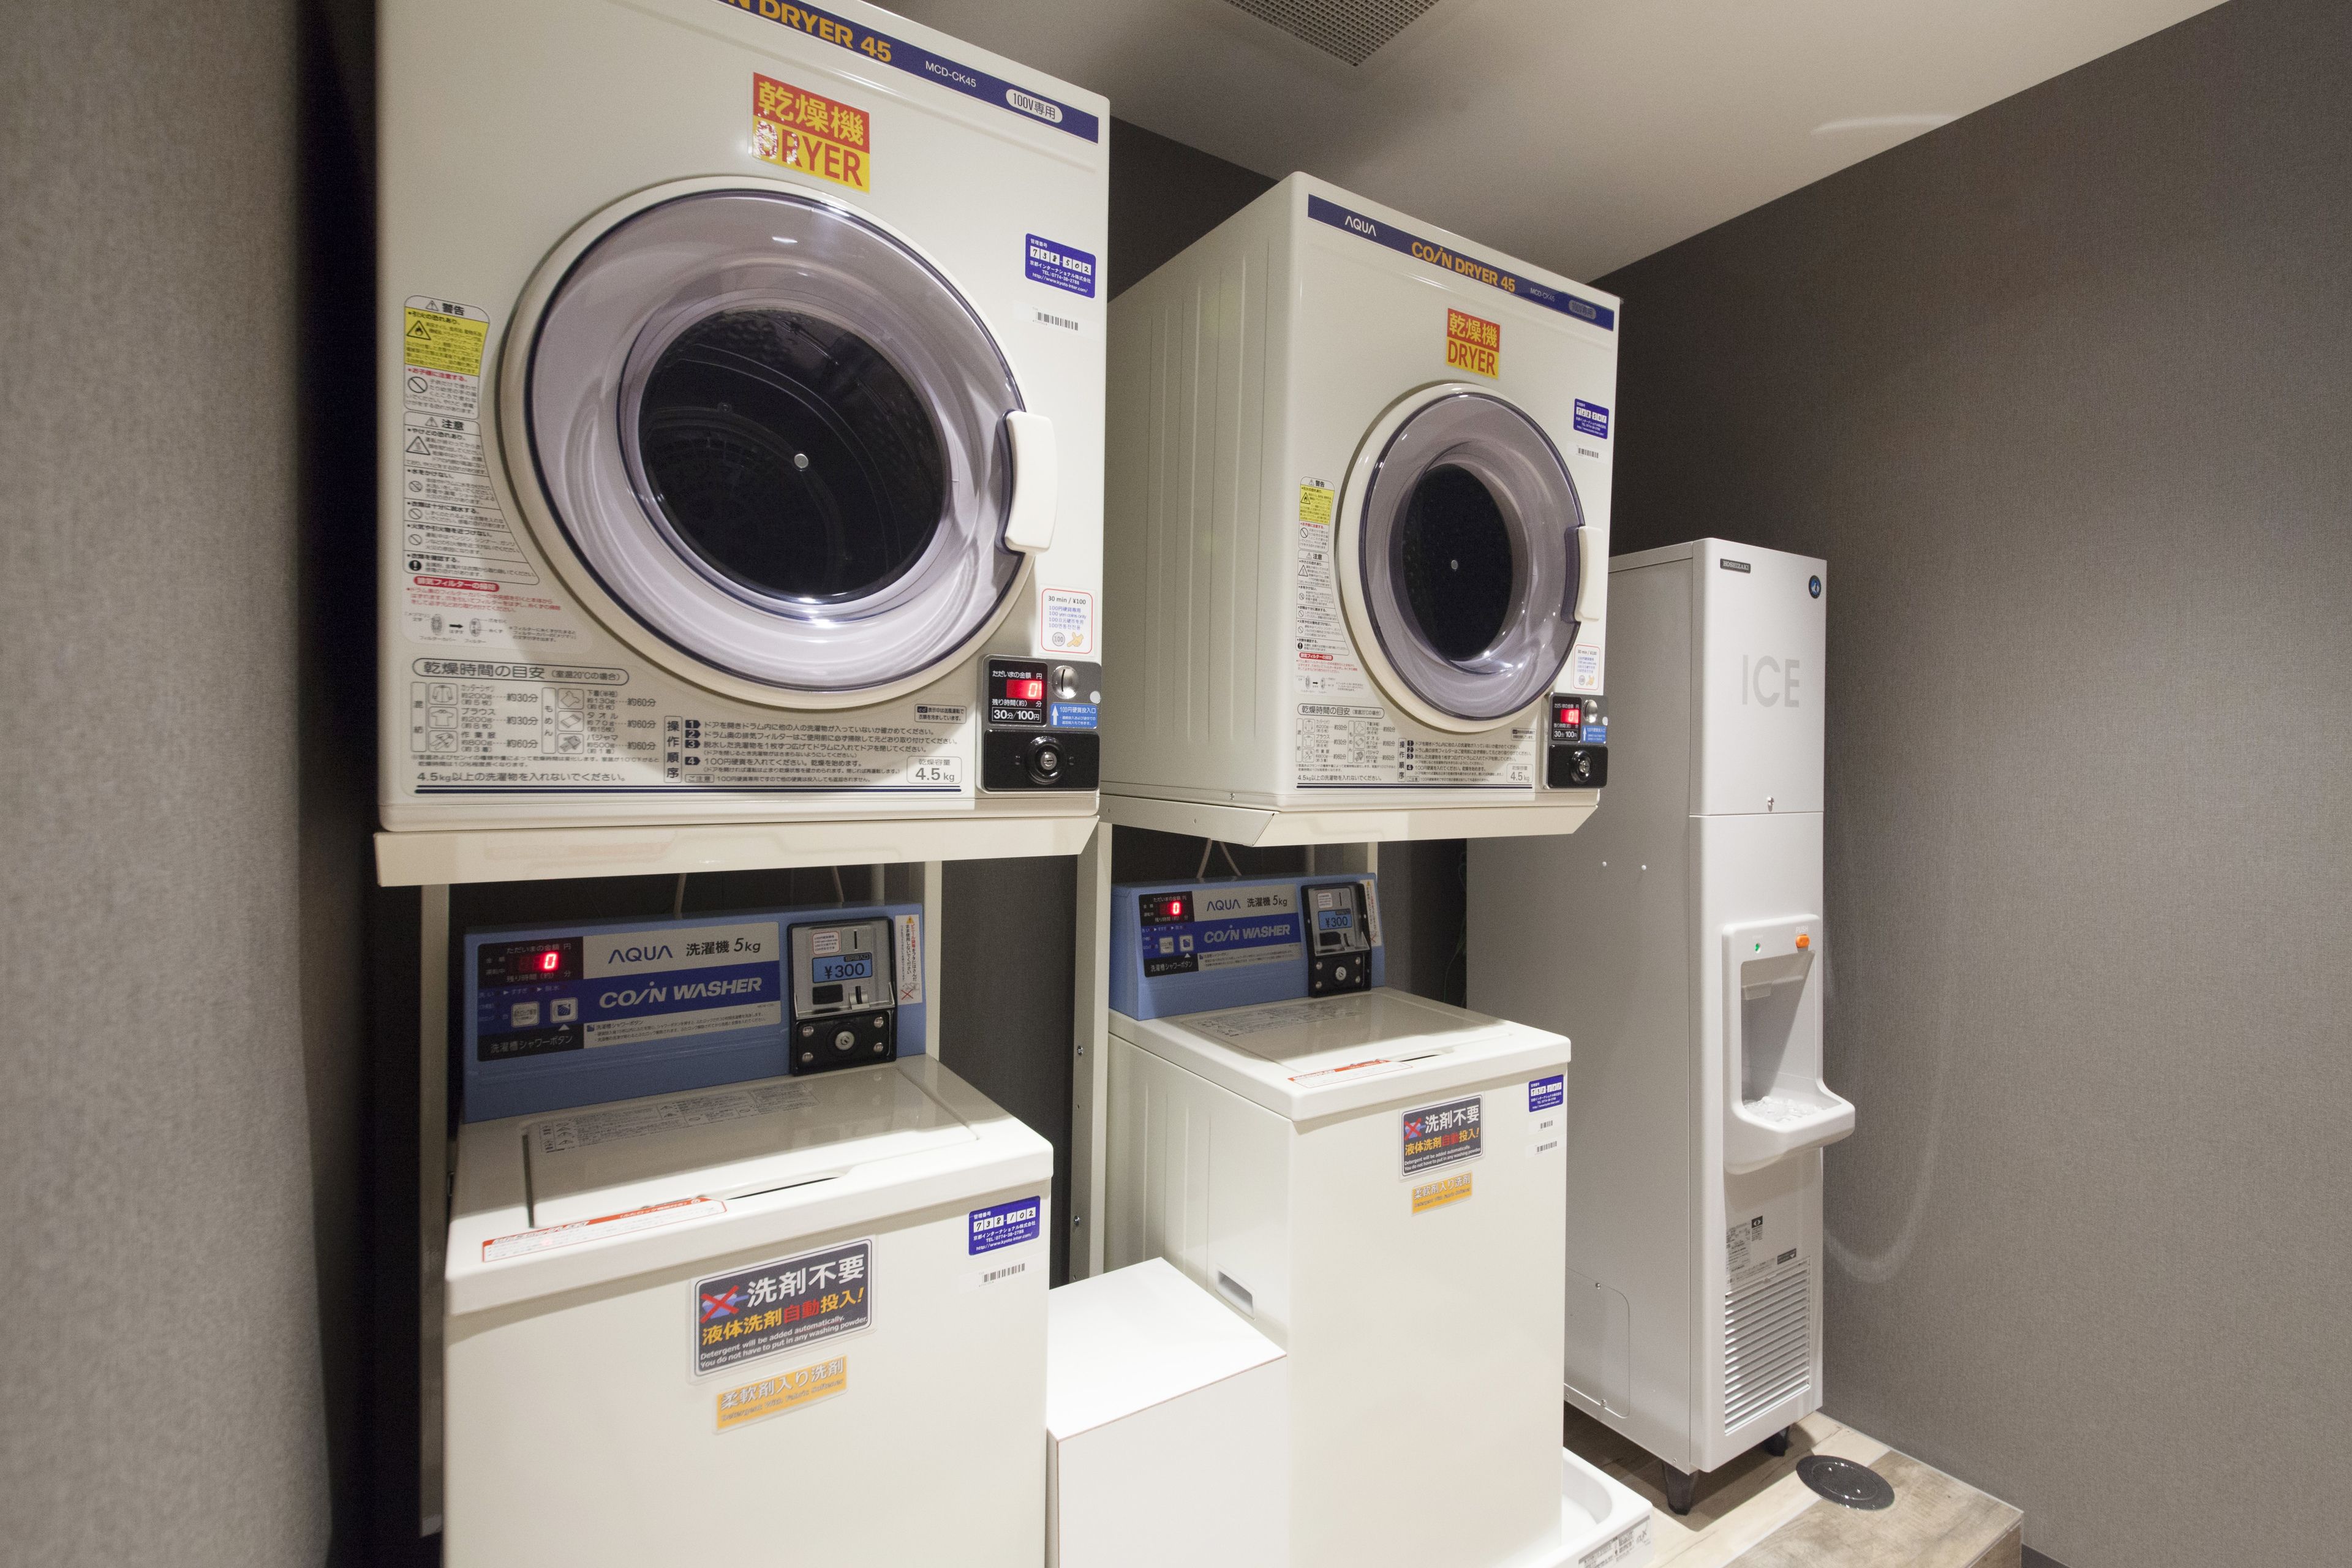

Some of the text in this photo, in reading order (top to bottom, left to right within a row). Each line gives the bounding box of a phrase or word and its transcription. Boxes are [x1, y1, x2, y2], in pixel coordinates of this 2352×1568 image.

[759, 0, 892, 62] DRYER 45
[925, 60, 977, 88] MCD-CK45
[758, 81, 864, 146] 乾燥機
[1012, 92, 1056, 120] 100V専用
[757, 120, 864, 187] DRYER
[1344, 215, 1377, 237] AQUA
[1030, 238, 1048, 249] 管理番号
[1030, 260, 1091, 284] 京都インターナショナル株式会社
[1411, 241, 1517, 294] COIN DRYER 45
[1530, 287, 1556, 303] MCD-CK45
[442, 302, 465, 316] 警告
[1449, 312, 1498, 349] 乾燥機
[1447, 339, 1496, 376] DRYER
[441, 418, 464, 431] 注意
[1723, 560, 1749, 571] HOSHIZAKI
[423, 661, 545, 679] 乾燥時間の目安
[992, 670, 1031, 679] ただいまの金額
[1741, 654, 1801, 709] ICE
[506, 693, 539, 703] 約30分
[627, 698, 657, 707] 約60分
[993, 709, 1040, 721] 30分/100円
[1302, 706, 1351, 715] 乾燥時間の目安
[506, 716, 539, 726] 約30分
[627, 720, 657, 729] 約60分
[506, 739, 539, 749] 約60分
[627, 741, 657, 751] 約60分
[666, 720, 680, 779] 操作順序
[417, 771, 626, 783] 4.5kg以上の洗濯物を入れないでください。
[915, 767, 955, 783] 4.5 kg
[1510, 771, 1523, 781] 4.5
[1172, 903, 1180, 914] 0
[1206, 894, 1288, 912] AQUA 洗濯機 5kg
[1325, 916, 1348, 928] ¥300
[1795, 925, 1809, 933] PUSH
[1204, 924, 1291, 943] COIN WASHER
[507, 944, 560, 954] ただいまの金額
[608, 937, 761, 964] AQUA 洗濯機 5kg
[544, 953, 557, 970] 0
[824, 962, 865, 979] ¥300
[599, 977, 763, 1009] COIN WASHER
[490, 1035, 573, 1054] 洗濯槽シャワーボタン
[1424, 1104, 1480, 1134] 洗剤不要
[1404, 1155, 1423, 1166] Detergent
[1435, 1149, 1447, 1158] added
[1453, 1149, 1468, 1159] washing
[1414, 1173, 1471, 1200] 柔軟剤入り洗剤
[973, 1220, 1036, 1242] 京都インターナショナル株式会社
[746, 1253, 865, 1308] 洗剤不要
[701, 1287, 865, 1346] 液体洗剤自動投入!
[700, 1315, 845, 1362] Detergent will be added automatically.
[701, 1316, 868, 1370] You do not have to put in any washing powder.
[720, 1358, 844, 1411] 柔軟剤入り洗剤
